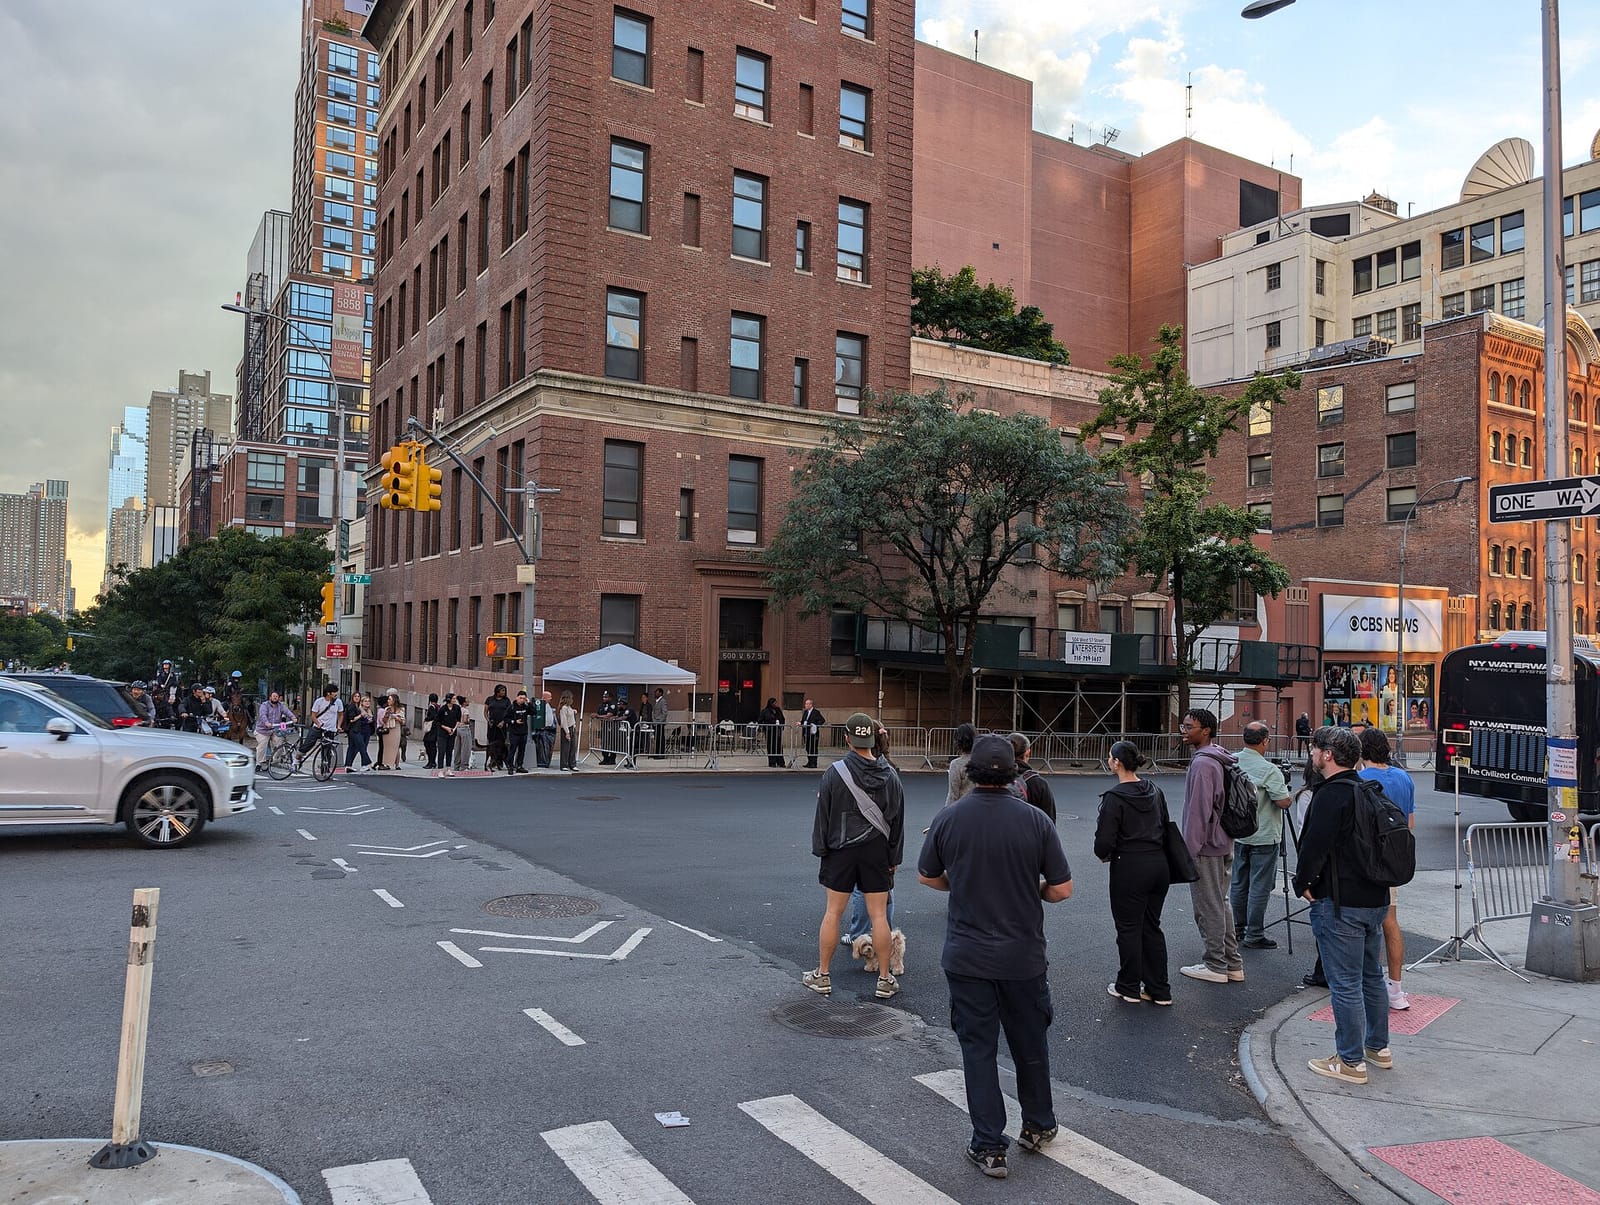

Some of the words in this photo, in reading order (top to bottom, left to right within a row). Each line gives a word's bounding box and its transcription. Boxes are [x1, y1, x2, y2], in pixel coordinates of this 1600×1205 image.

[345, 287, 360, 300] 581
[337, 297, 361, 310] 5858
[334, 342, 361, 352] LUXURY
[1500, 494, 1535, 510] ONE
[1557, 488, 1598, 505] WAY
[354, 575, 362, 583] 57
[1360, 616, 1382, 632] CBS
[1385, 617, 1418, 633] NEWS
[1488, 661, 1547, 669] WATERWA
[855, 726, 871, 736] 224
[1487, 721, 1547, 733] WATERWAY
[1467, 767, 1480, 775] The
[1481, 769, 1510, 779] Civilized
